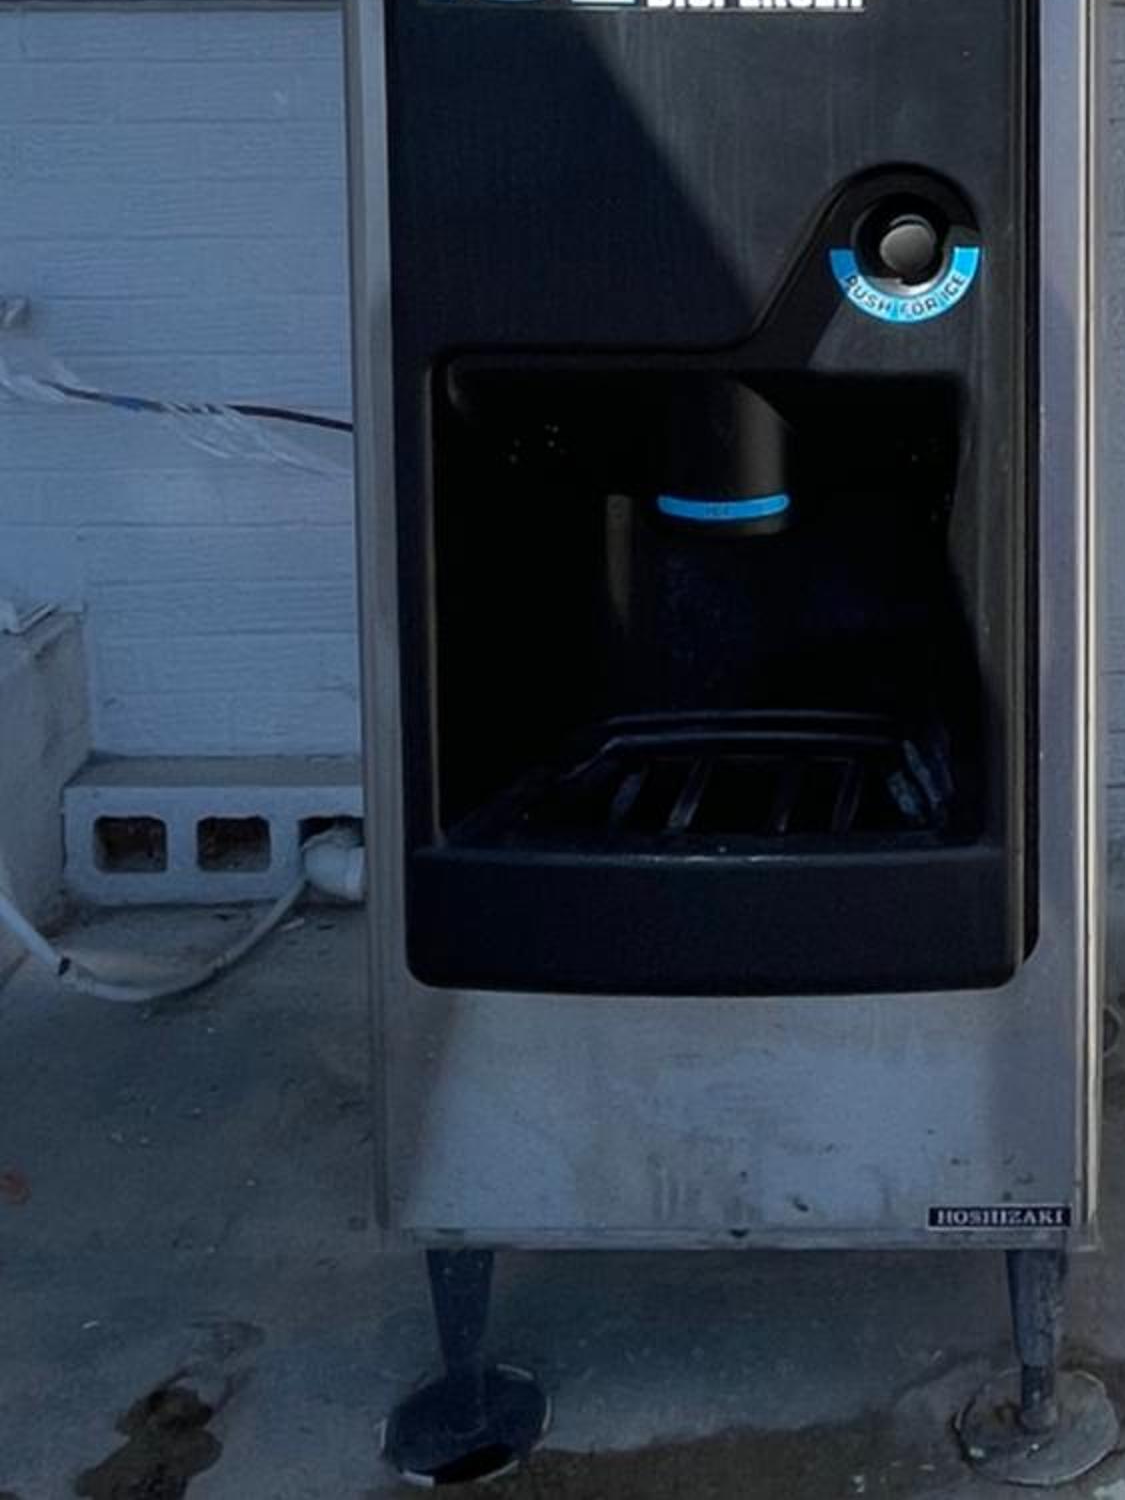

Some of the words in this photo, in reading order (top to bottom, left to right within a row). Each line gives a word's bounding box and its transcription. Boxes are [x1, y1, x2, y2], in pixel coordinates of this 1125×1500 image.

[846, 275, 891, 313] PUSH
[941, 273, 965, 302] ICE
[936, 1209, 1063, 1225] HOSHIZAKI
